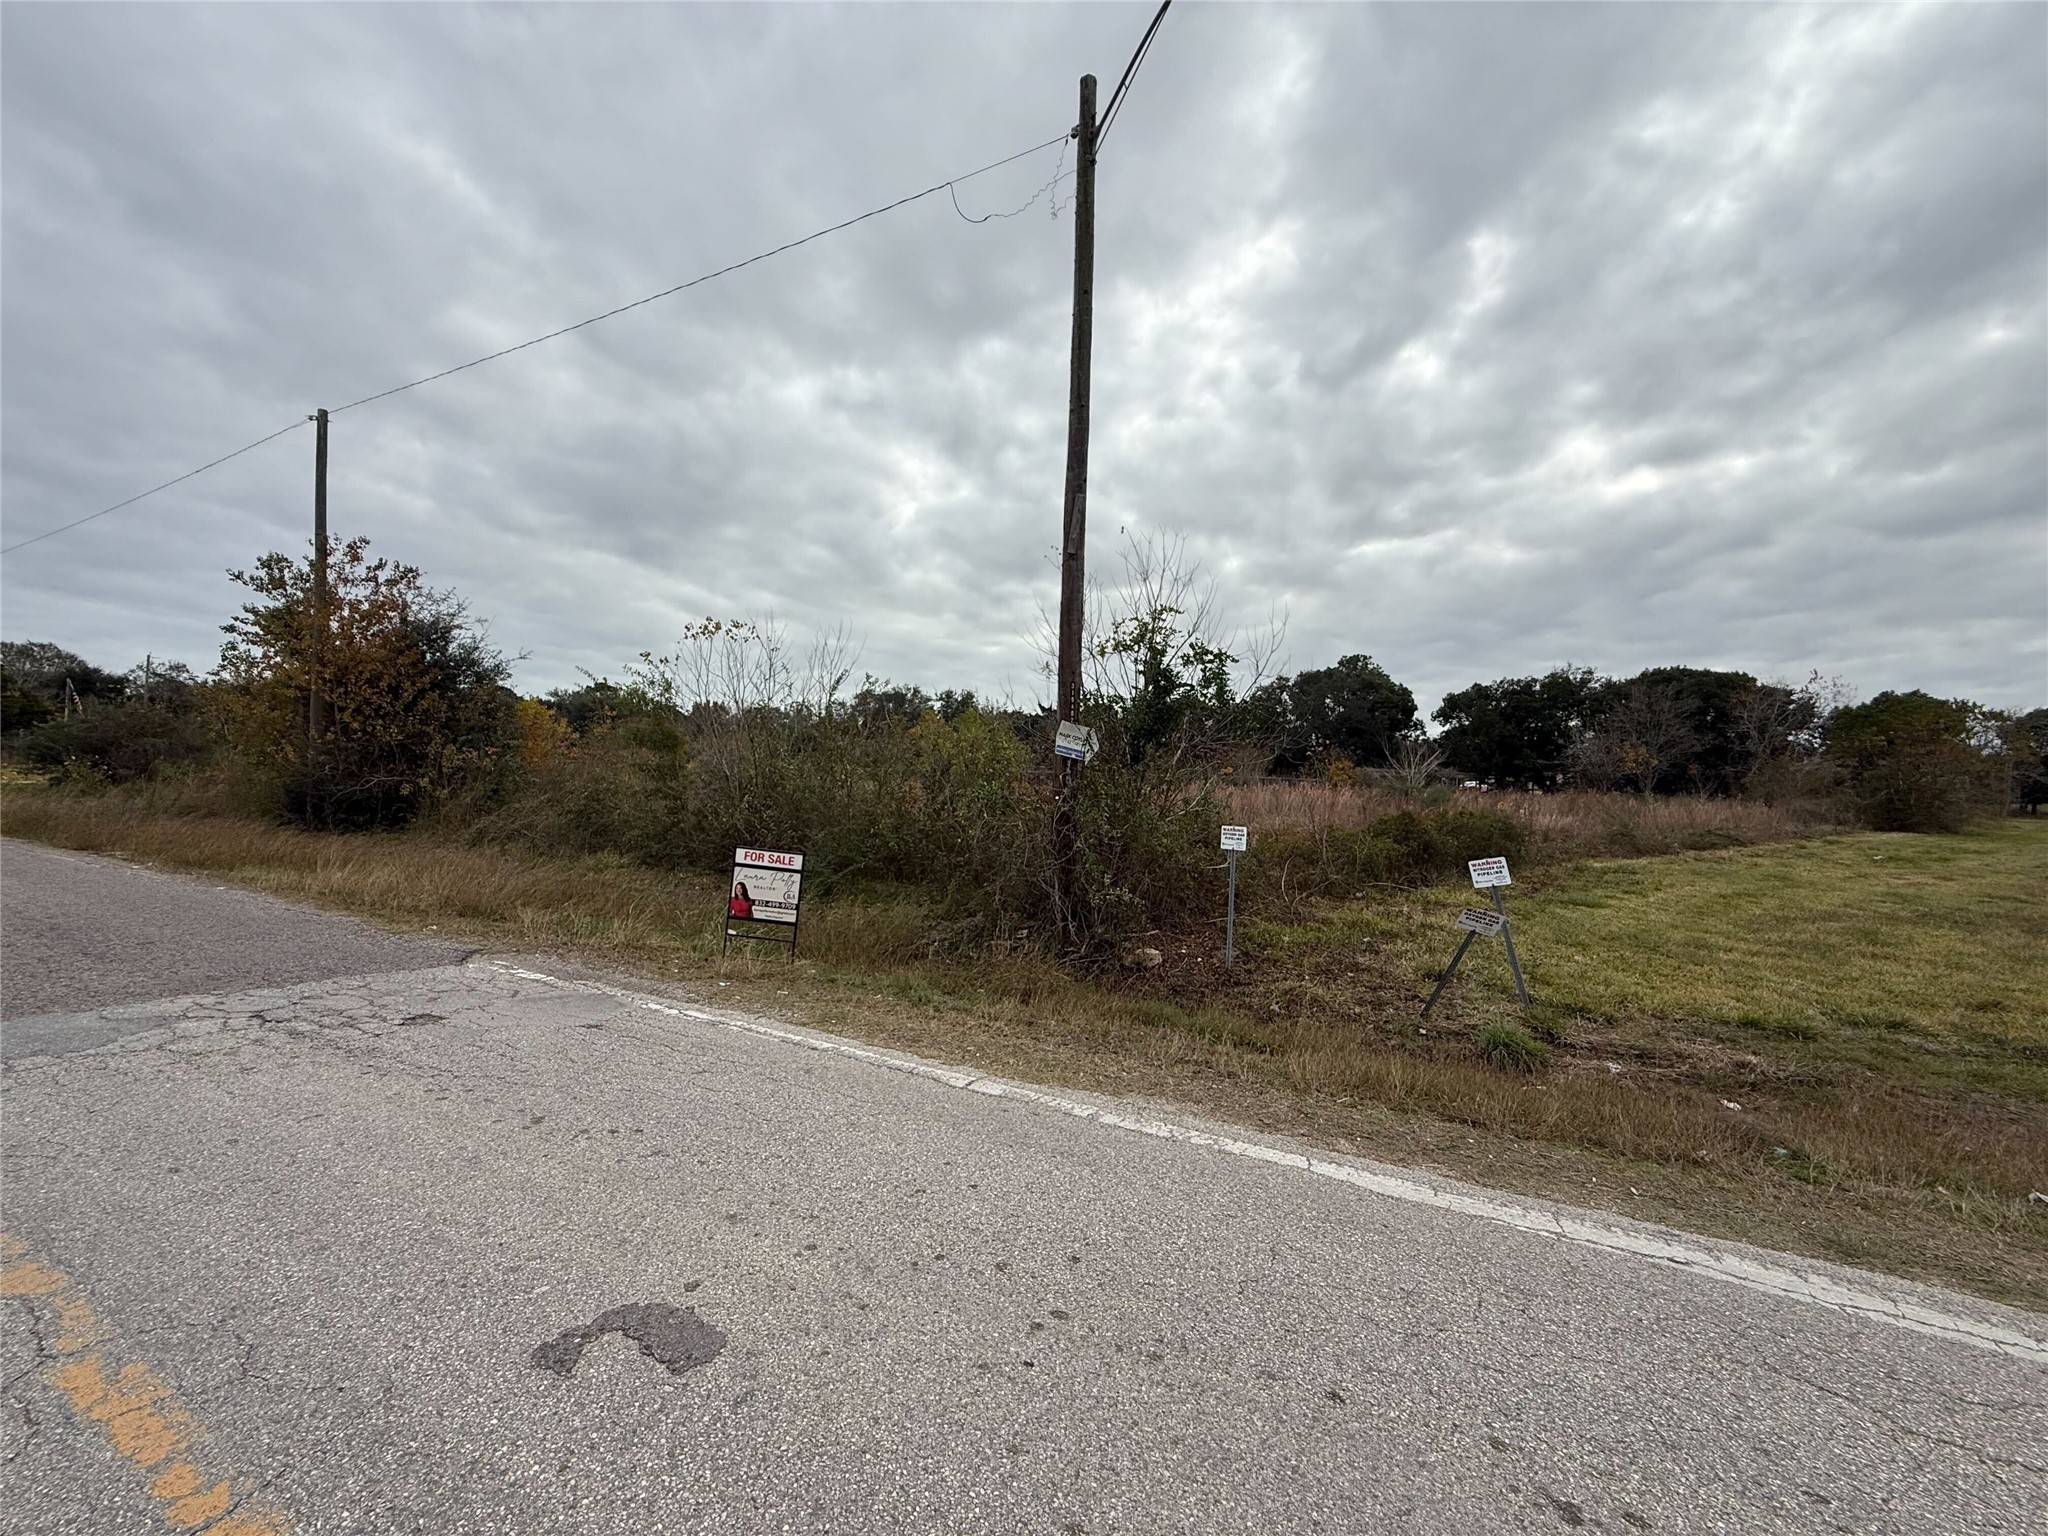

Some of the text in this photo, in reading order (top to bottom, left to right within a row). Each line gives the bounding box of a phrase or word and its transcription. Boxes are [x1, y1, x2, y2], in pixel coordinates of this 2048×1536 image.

[744, 851, 796, 867] FOR SALE
[1471, 860, 1503, 868] WARNING
[735, 867, 798, 891] Laura Polly
[754, 900, 796, 910] 832-499-9709
[1466, 908, 1500, 921] WARNING
[1465, 916, 1494, 928] PIPELINE
